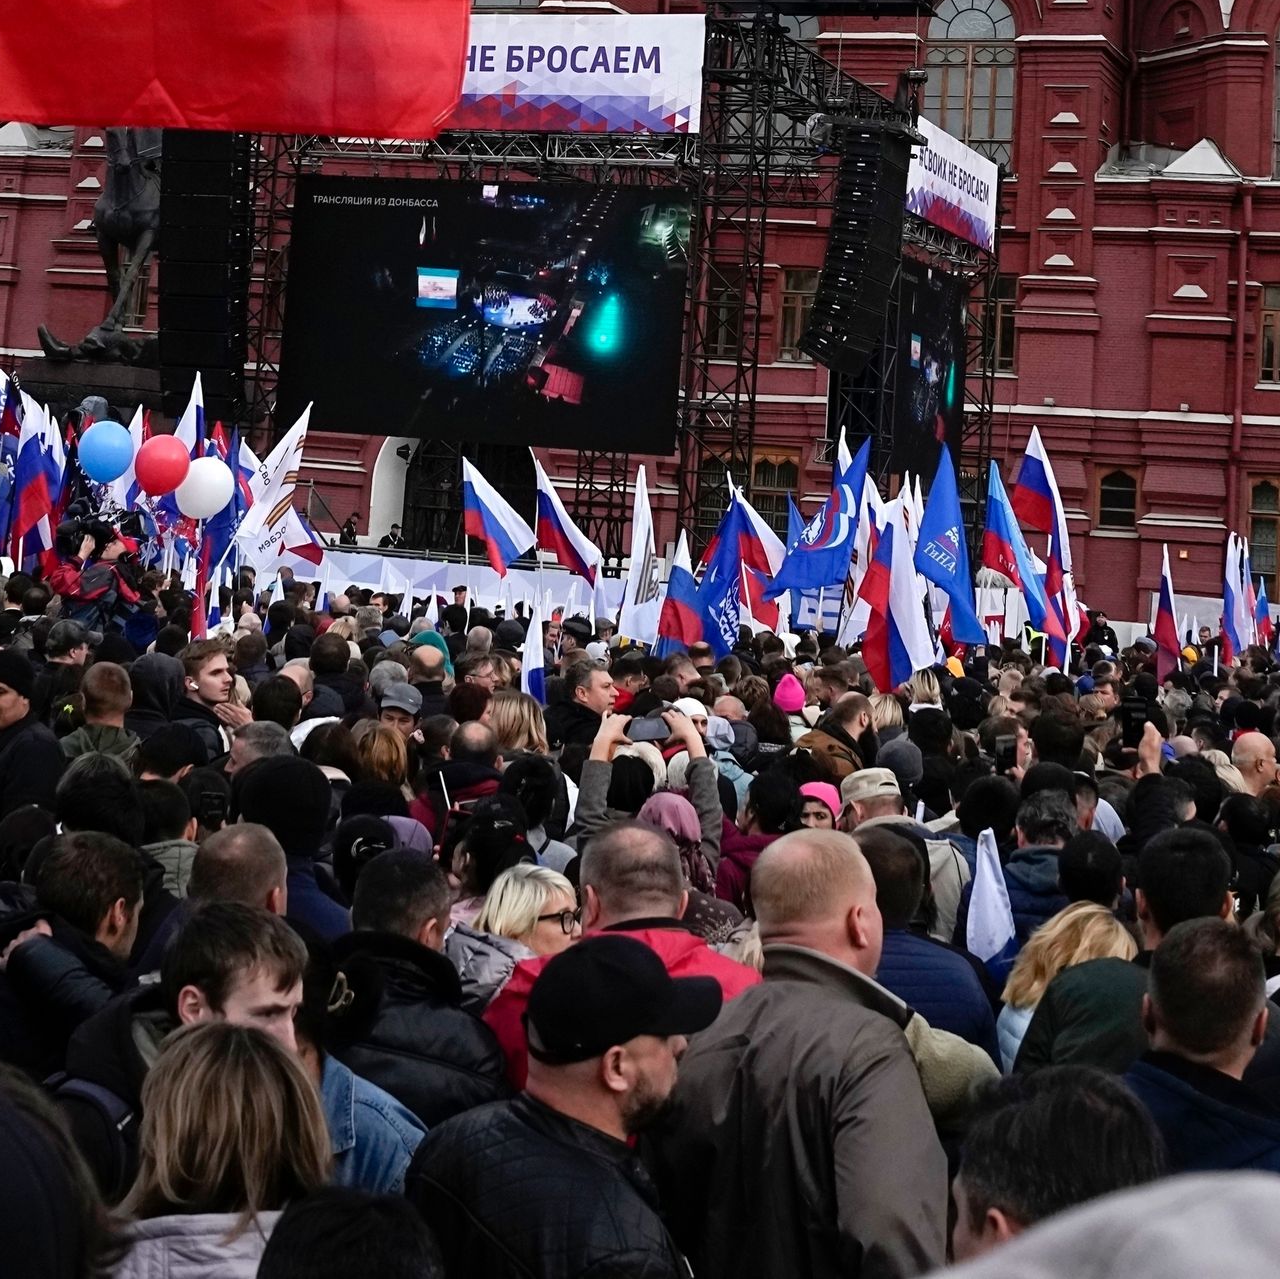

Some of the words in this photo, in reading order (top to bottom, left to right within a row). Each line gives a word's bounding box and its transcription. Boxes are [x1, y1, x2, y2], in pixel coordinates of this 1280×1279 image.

[506, 45, 661, 74] БРОСАЕМ
[948, 161, 957, 187] НЕ
[959, 168, 990, 206] БРОСАЕМ
[313, 195, 372, 205] ТРАНСЛЯЦИЯ
[374, 197, 386, 206] ИЗ
[388, 197, 439, 207] ДОНБАССА
